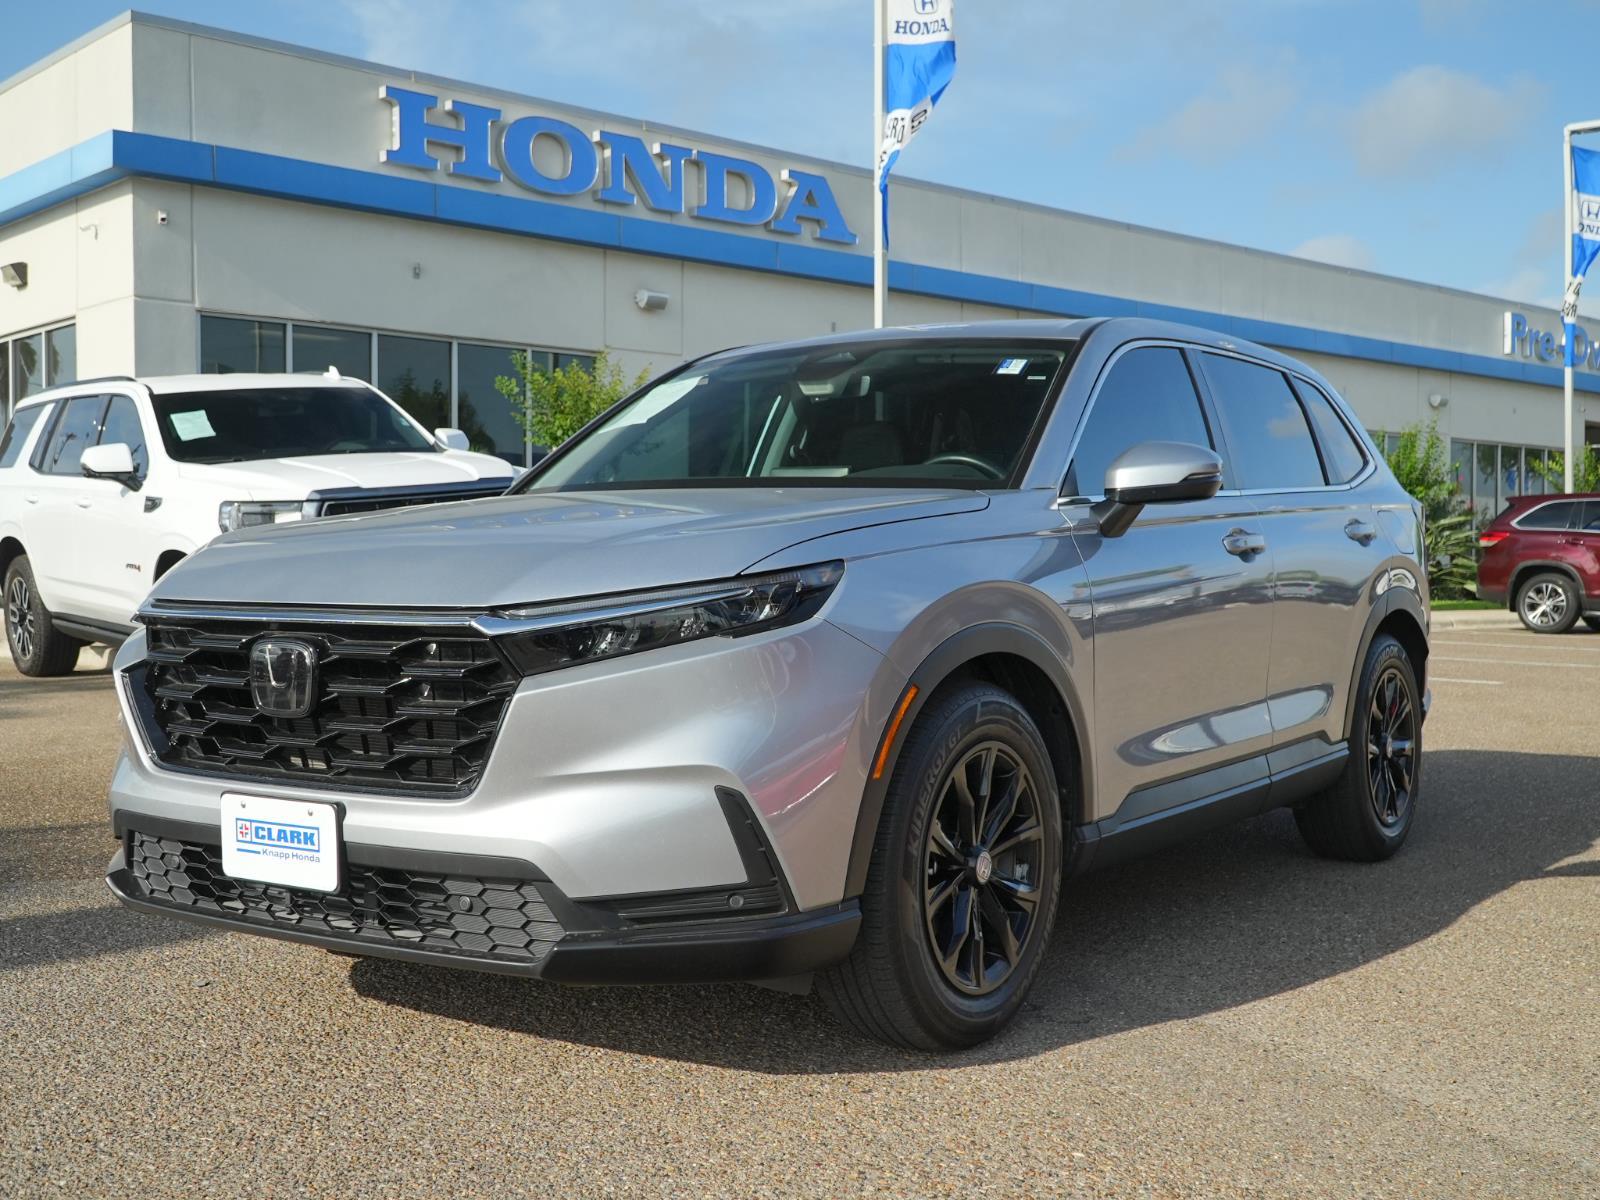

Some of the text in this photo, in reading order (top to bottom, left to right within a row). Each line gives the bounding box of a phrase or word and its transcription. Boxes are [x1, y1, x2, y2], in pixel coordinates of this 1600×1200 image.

[894, 18, 950, 35] HONDA
[380, 85, 858, 244] HONDA
[254, 825, 316, 846] CLARK
[262, 848, 320, 863] Knapp Honda
